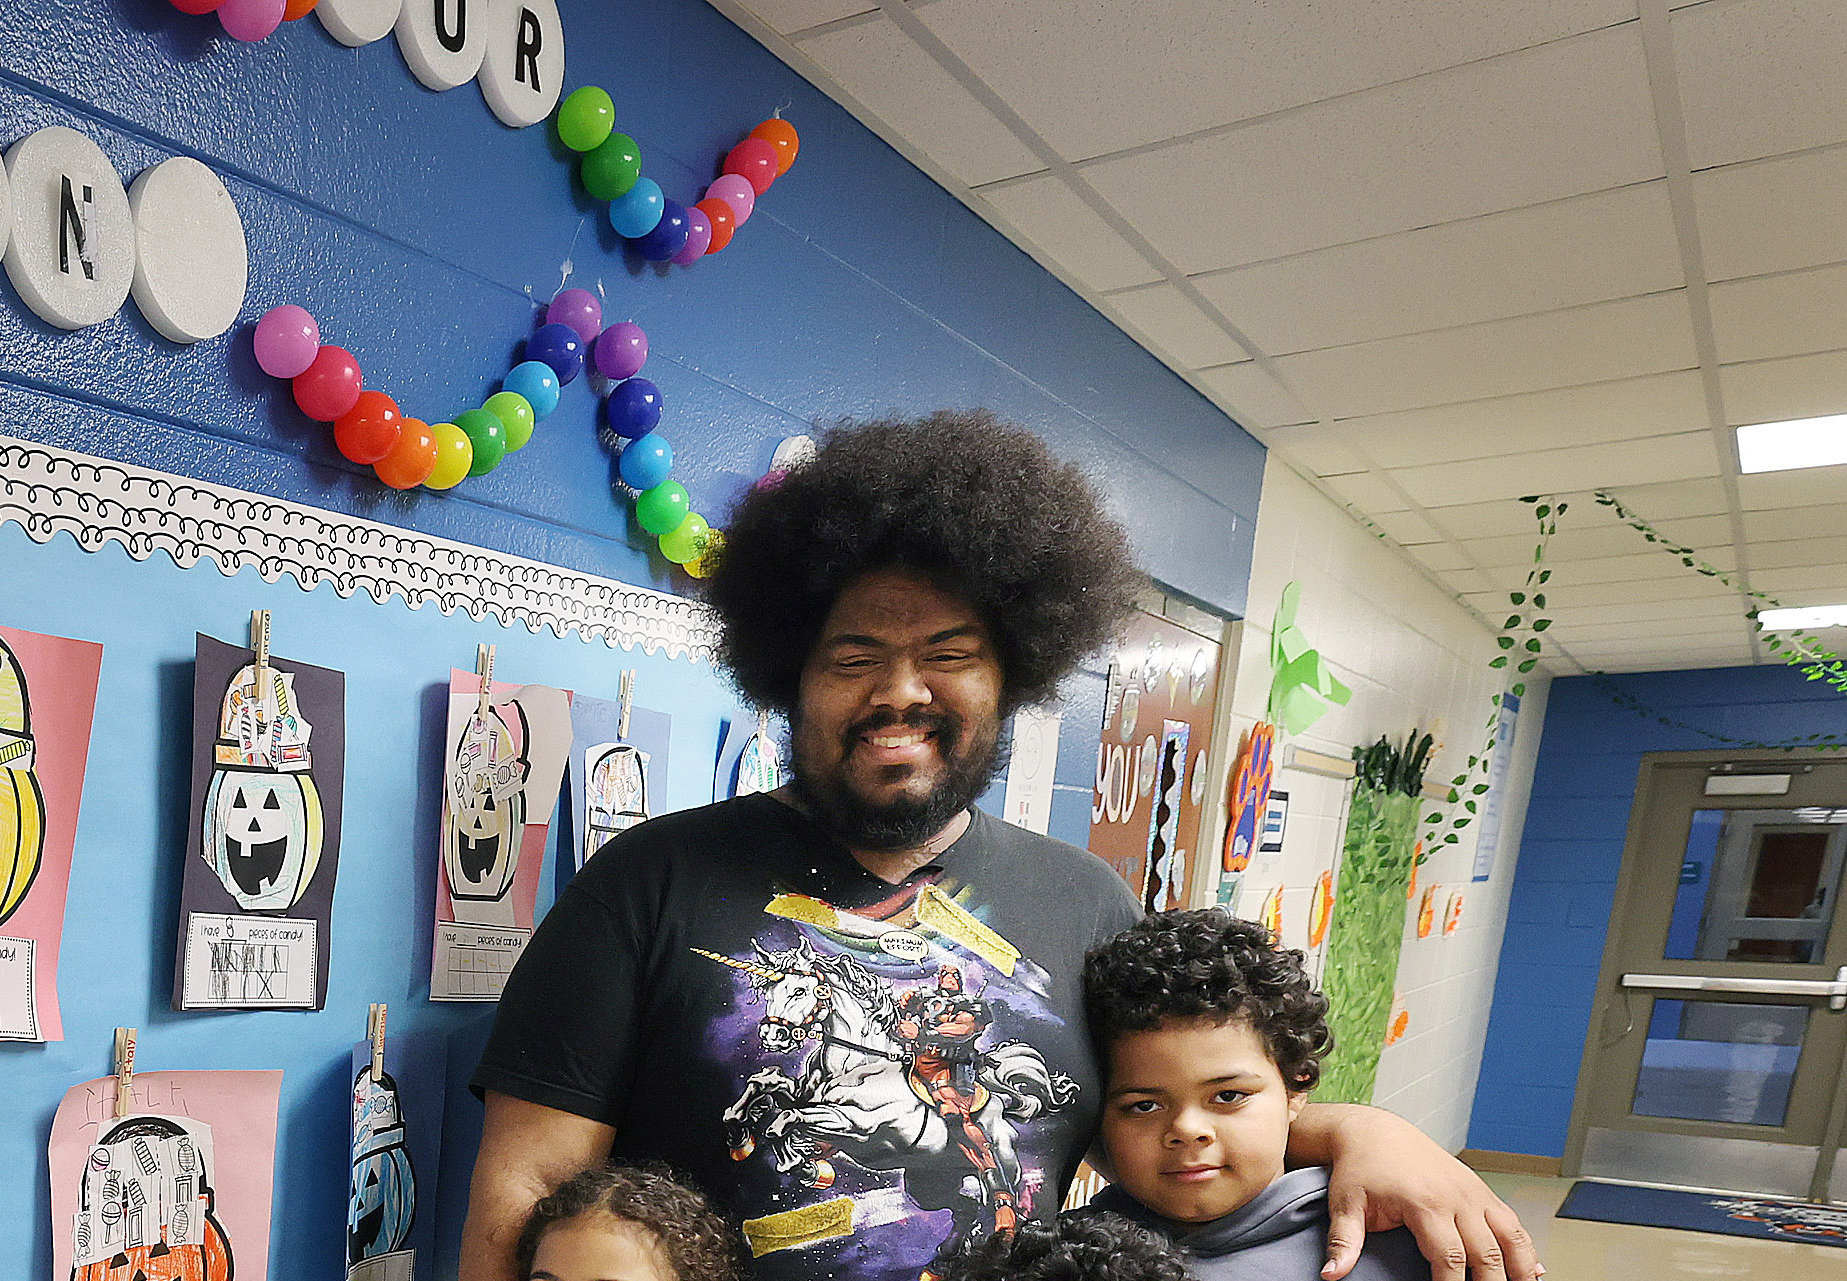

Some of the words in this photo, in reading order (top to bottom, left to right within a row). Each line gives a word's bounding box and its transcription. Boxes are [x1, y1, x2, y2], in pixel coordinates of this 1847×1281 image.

[248, 928, 269, 940] pieces
[270, 928, 278, 939] of
[124, 1039, 136, 1078] Italy
